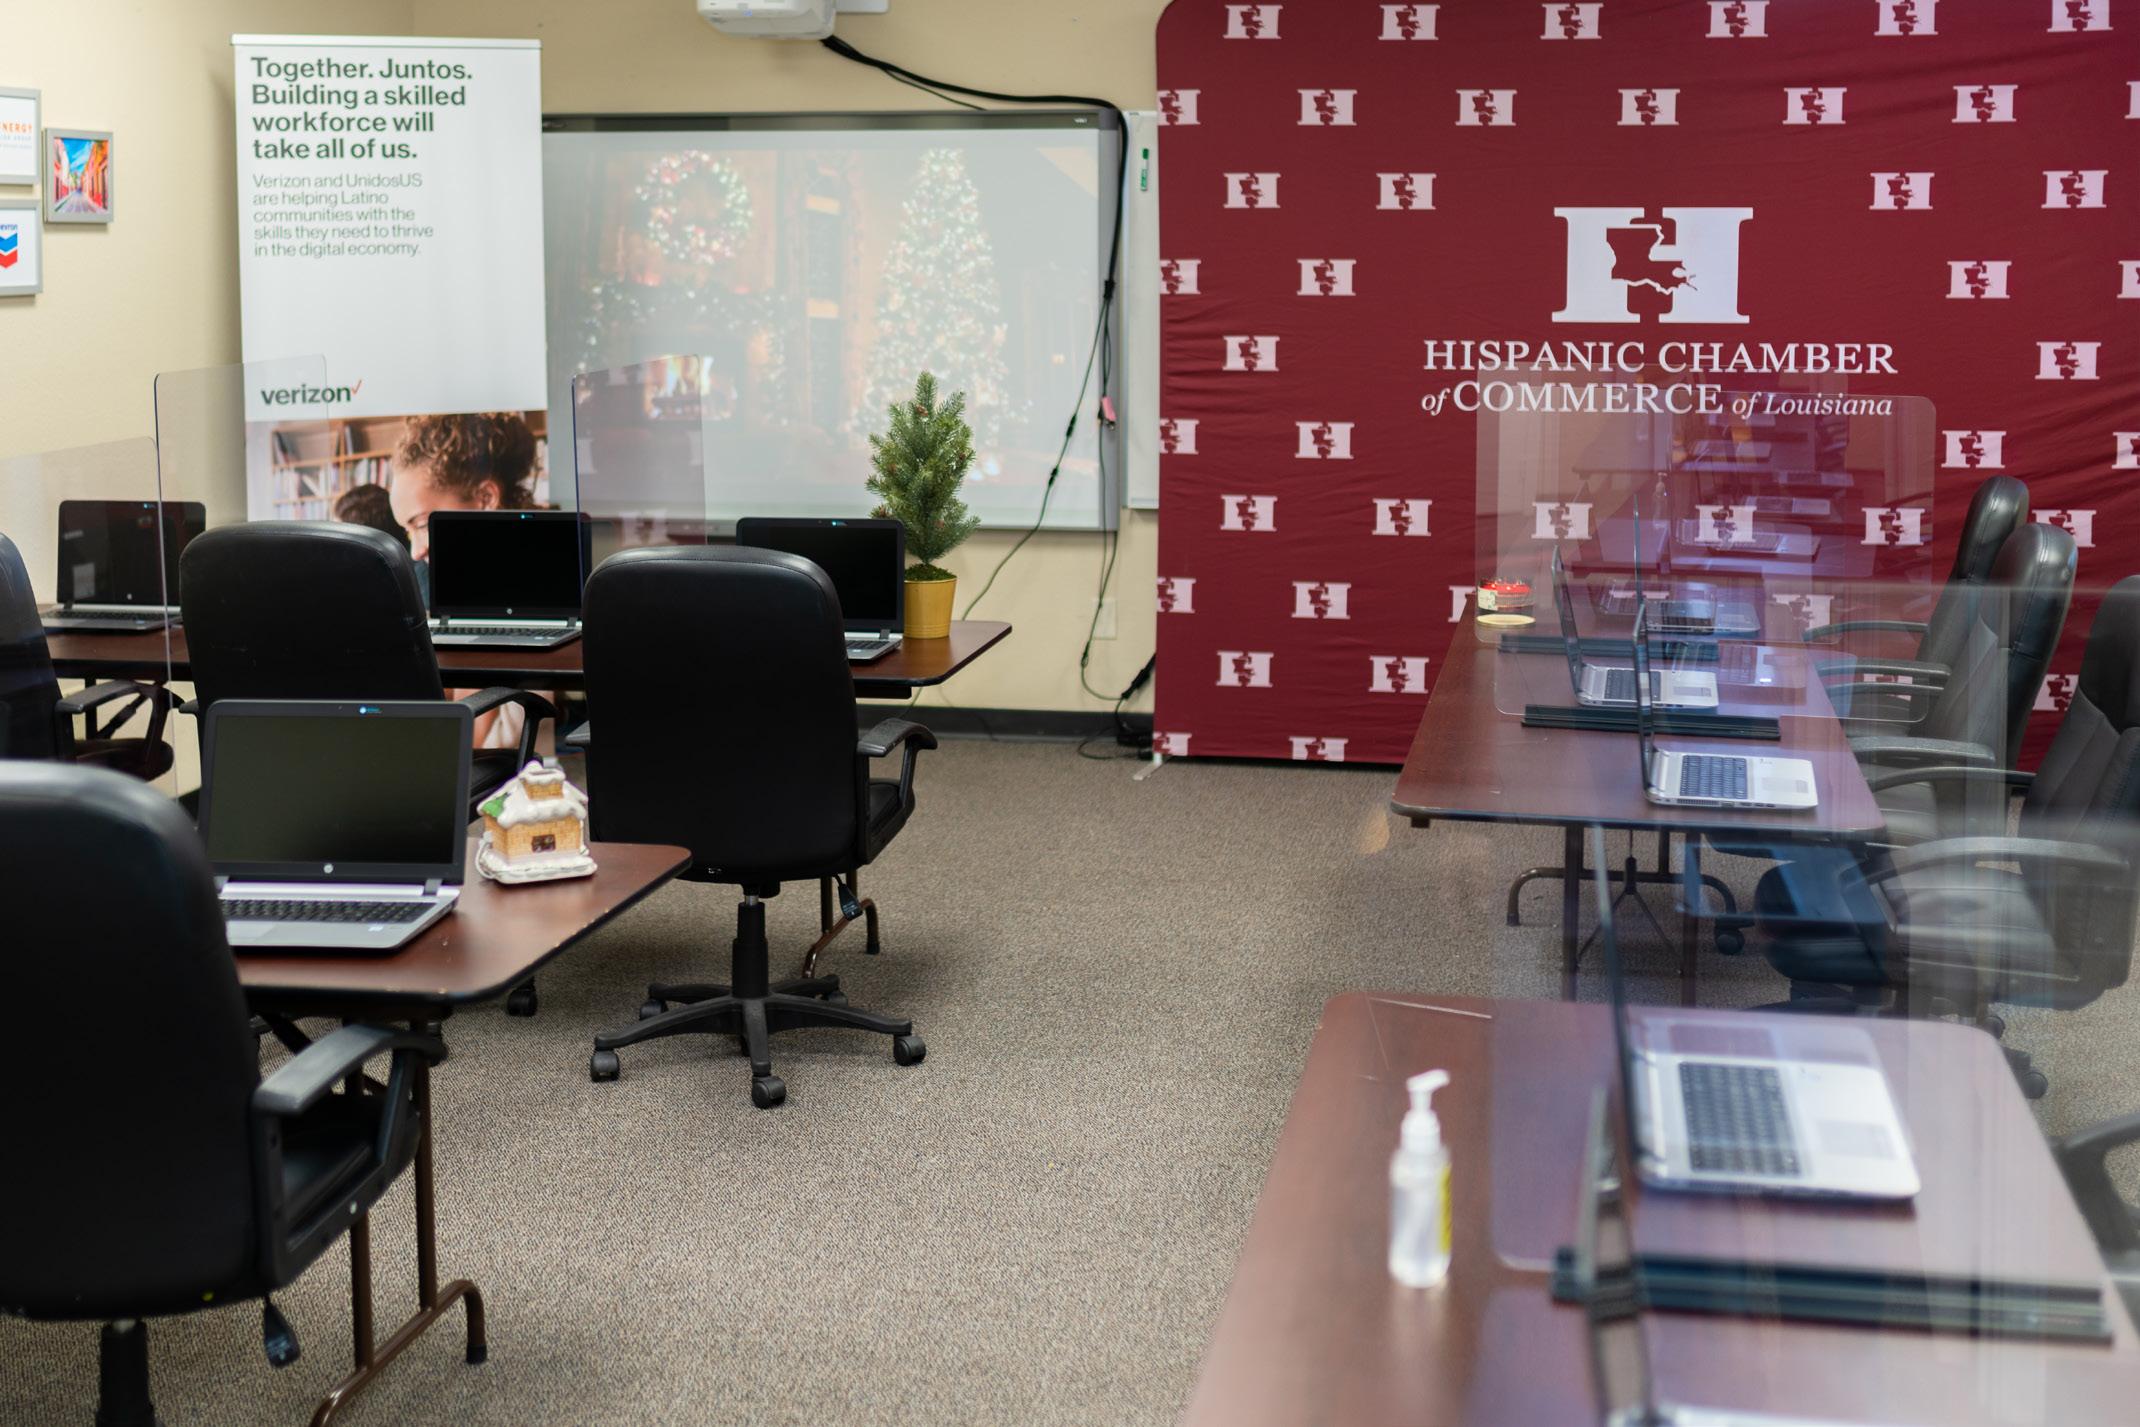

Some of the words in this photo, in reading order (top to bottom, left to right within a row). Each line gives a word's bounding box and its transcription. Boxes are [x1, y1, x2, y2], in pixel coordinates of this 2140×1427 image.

[250, 57, 374, 81] Together.
[379, 58, 473, 80] Juntos.
[252, 84, 358, 110] Building
[364, 89, 378, 105] a
[384, 85, 466, 106] skilled
[252, 111, 387, 132] workforce
[392, 112, 434, 132] will
[253, 139, 310, 159] take
[316, 139, 345, 159] all
[350, 138, 376, 159] of
[381, 143, 417, 159] us.
[252, 174, 311, 188] Verizon
[314, 174, 343, 188] and
[346, 173, 423, 188] UnidosUS
[252, 193, 279, 205] are
[282, 191, 338, 208] helping
[341, 190, 389, 205] Latino
[253, 208, 353, 222] communities
[356, 208, 388, 222] with
[391, 207, 416, 221] the
[254, 226, 292, 239] skills
[295, 226, 329, 242] they
[331, 225, 371, 238] need
[374, 226, 390, 238] to
[391, 225, 434, 238] thrive
[254, 243, 269, 256] in
[271, 243, 297, 256] the
[299, 242, 345, 259] digital
[347, 244, 421, 259] economy.
[1423, 339, 1645, 373] HISPANIC
[1658, 341, 1899, 374] CHAMBER
[260, 383, 352, 406] verizon
[1421, 387, 1451, 416] of
[1453, 380, 1724, 414] COMMERCE
[1732, 391, 1763, 420] of
[1764, 391, 1893, 416] Louisiana
